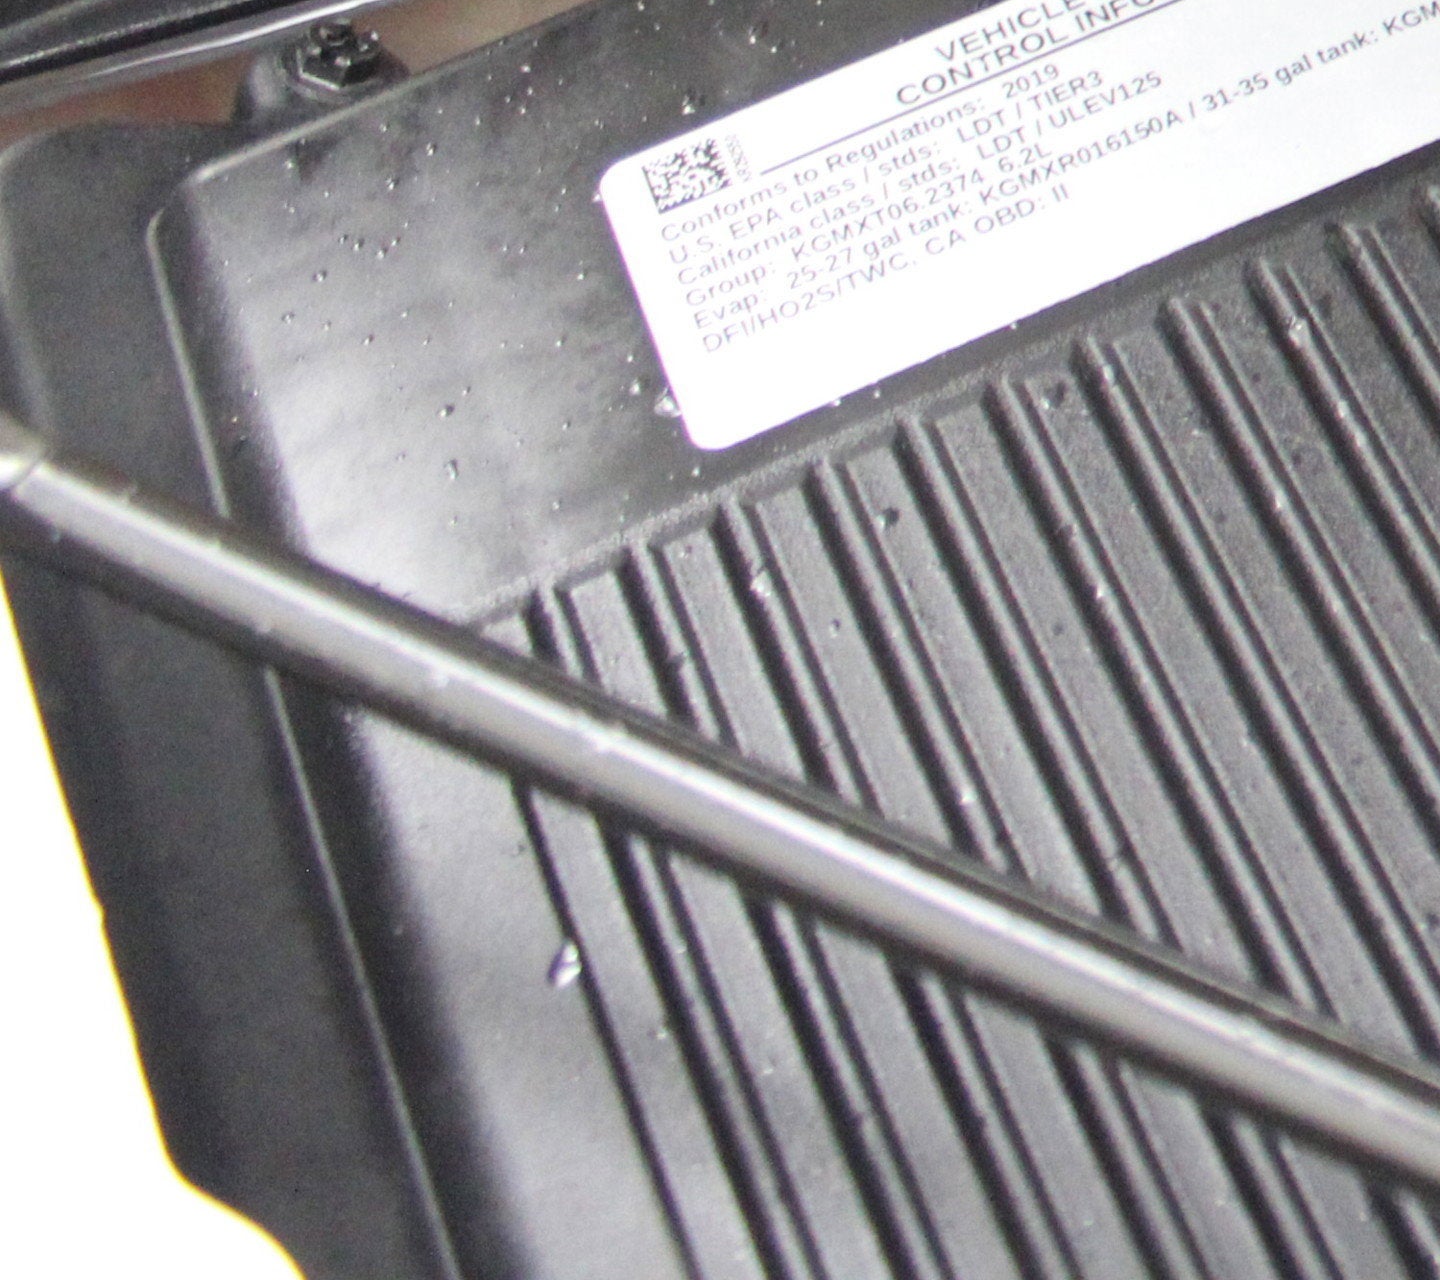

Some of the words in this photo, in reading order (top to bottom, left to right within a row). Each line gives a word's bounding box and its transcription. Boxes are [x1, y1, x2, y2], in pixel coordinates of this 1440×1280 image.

[661, 183, 787, 241] Conforms
[793, 169, 818, 186] to
[826, 99, 984, 172] Regulations:
[1002, 64, 1059, 99] 2019
[896, 28, 1068, 104] CONTROL
[669, 236, 721, 264] U.S.
[729, 208, 781, 239] EPA
[790, 179, 855, 213] class
[863, 166, 869, 183] /
[879, 143, 939, 175] stds:
[957, 109, 1004, 143] LDT
[1016, 102, 1022, 120] /
[1027, 71, 1103, 110] TIER3
[678, 226, 802, 284] California
[810, 195, 875, 228] class
[883, 183, 888, 200] /
[899, 159, 959, 191] stds:
[977, 126, 1025, 159] LDT
[1035, 119, 1042, 137] /
[1048, 71, 1162, 128] ULEV125
[686, 263, 774, 305] Group:
[792, 168, 984, 261] KGMXT06.2374
[998, 143, 1051, 172] 6.2L
[694, 294, 758, 329] Evap:
[787, 246, 851, 289] 25-27
[863, 227, 901, 261] gal
[909, 204, 961, 235] tank:
[979, 110, 1183, 205] KGMXR016150A
[1188, 101, 1195, 119] /
[1202, 73, 1269, 111] 31-35
[1275, 54, 1312, 86] gal
[1316, 31, 1378, 64] tank:
[925, 229, 965, 254] CA
[974, 199, 1044, 233] OBD:
[1052, 183, 1069, 202] II
